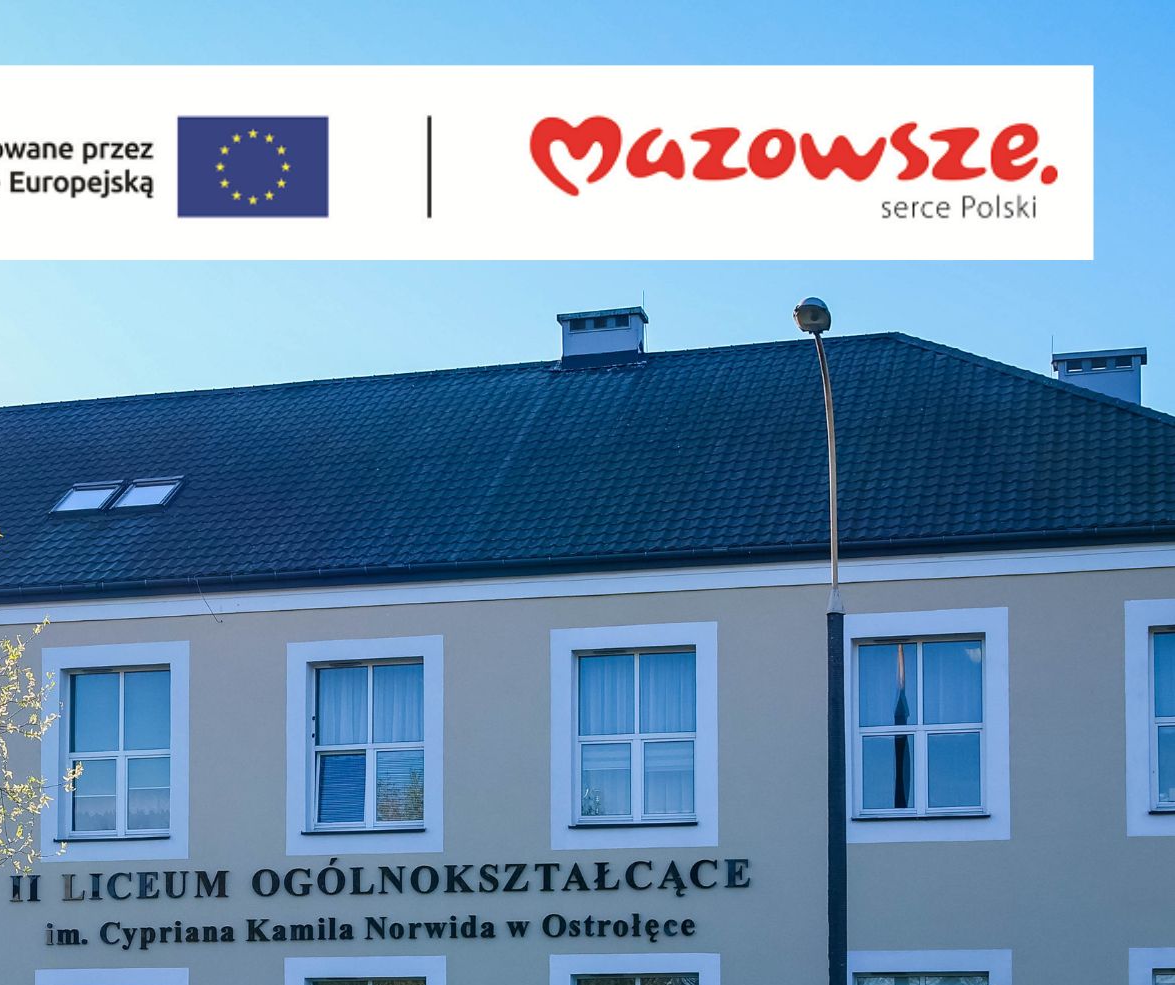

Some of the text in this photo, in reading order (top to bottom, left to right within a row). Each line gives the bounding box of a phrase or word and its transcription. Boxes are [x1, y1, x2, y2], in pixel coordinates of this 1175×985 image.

[9, 857, 751, 903] II LICEUM OGÓLNOKSZTAŁCĄCE
[45, 912, 697, 950] im. Cypriana Kamila Norwida w Ostrołęce
